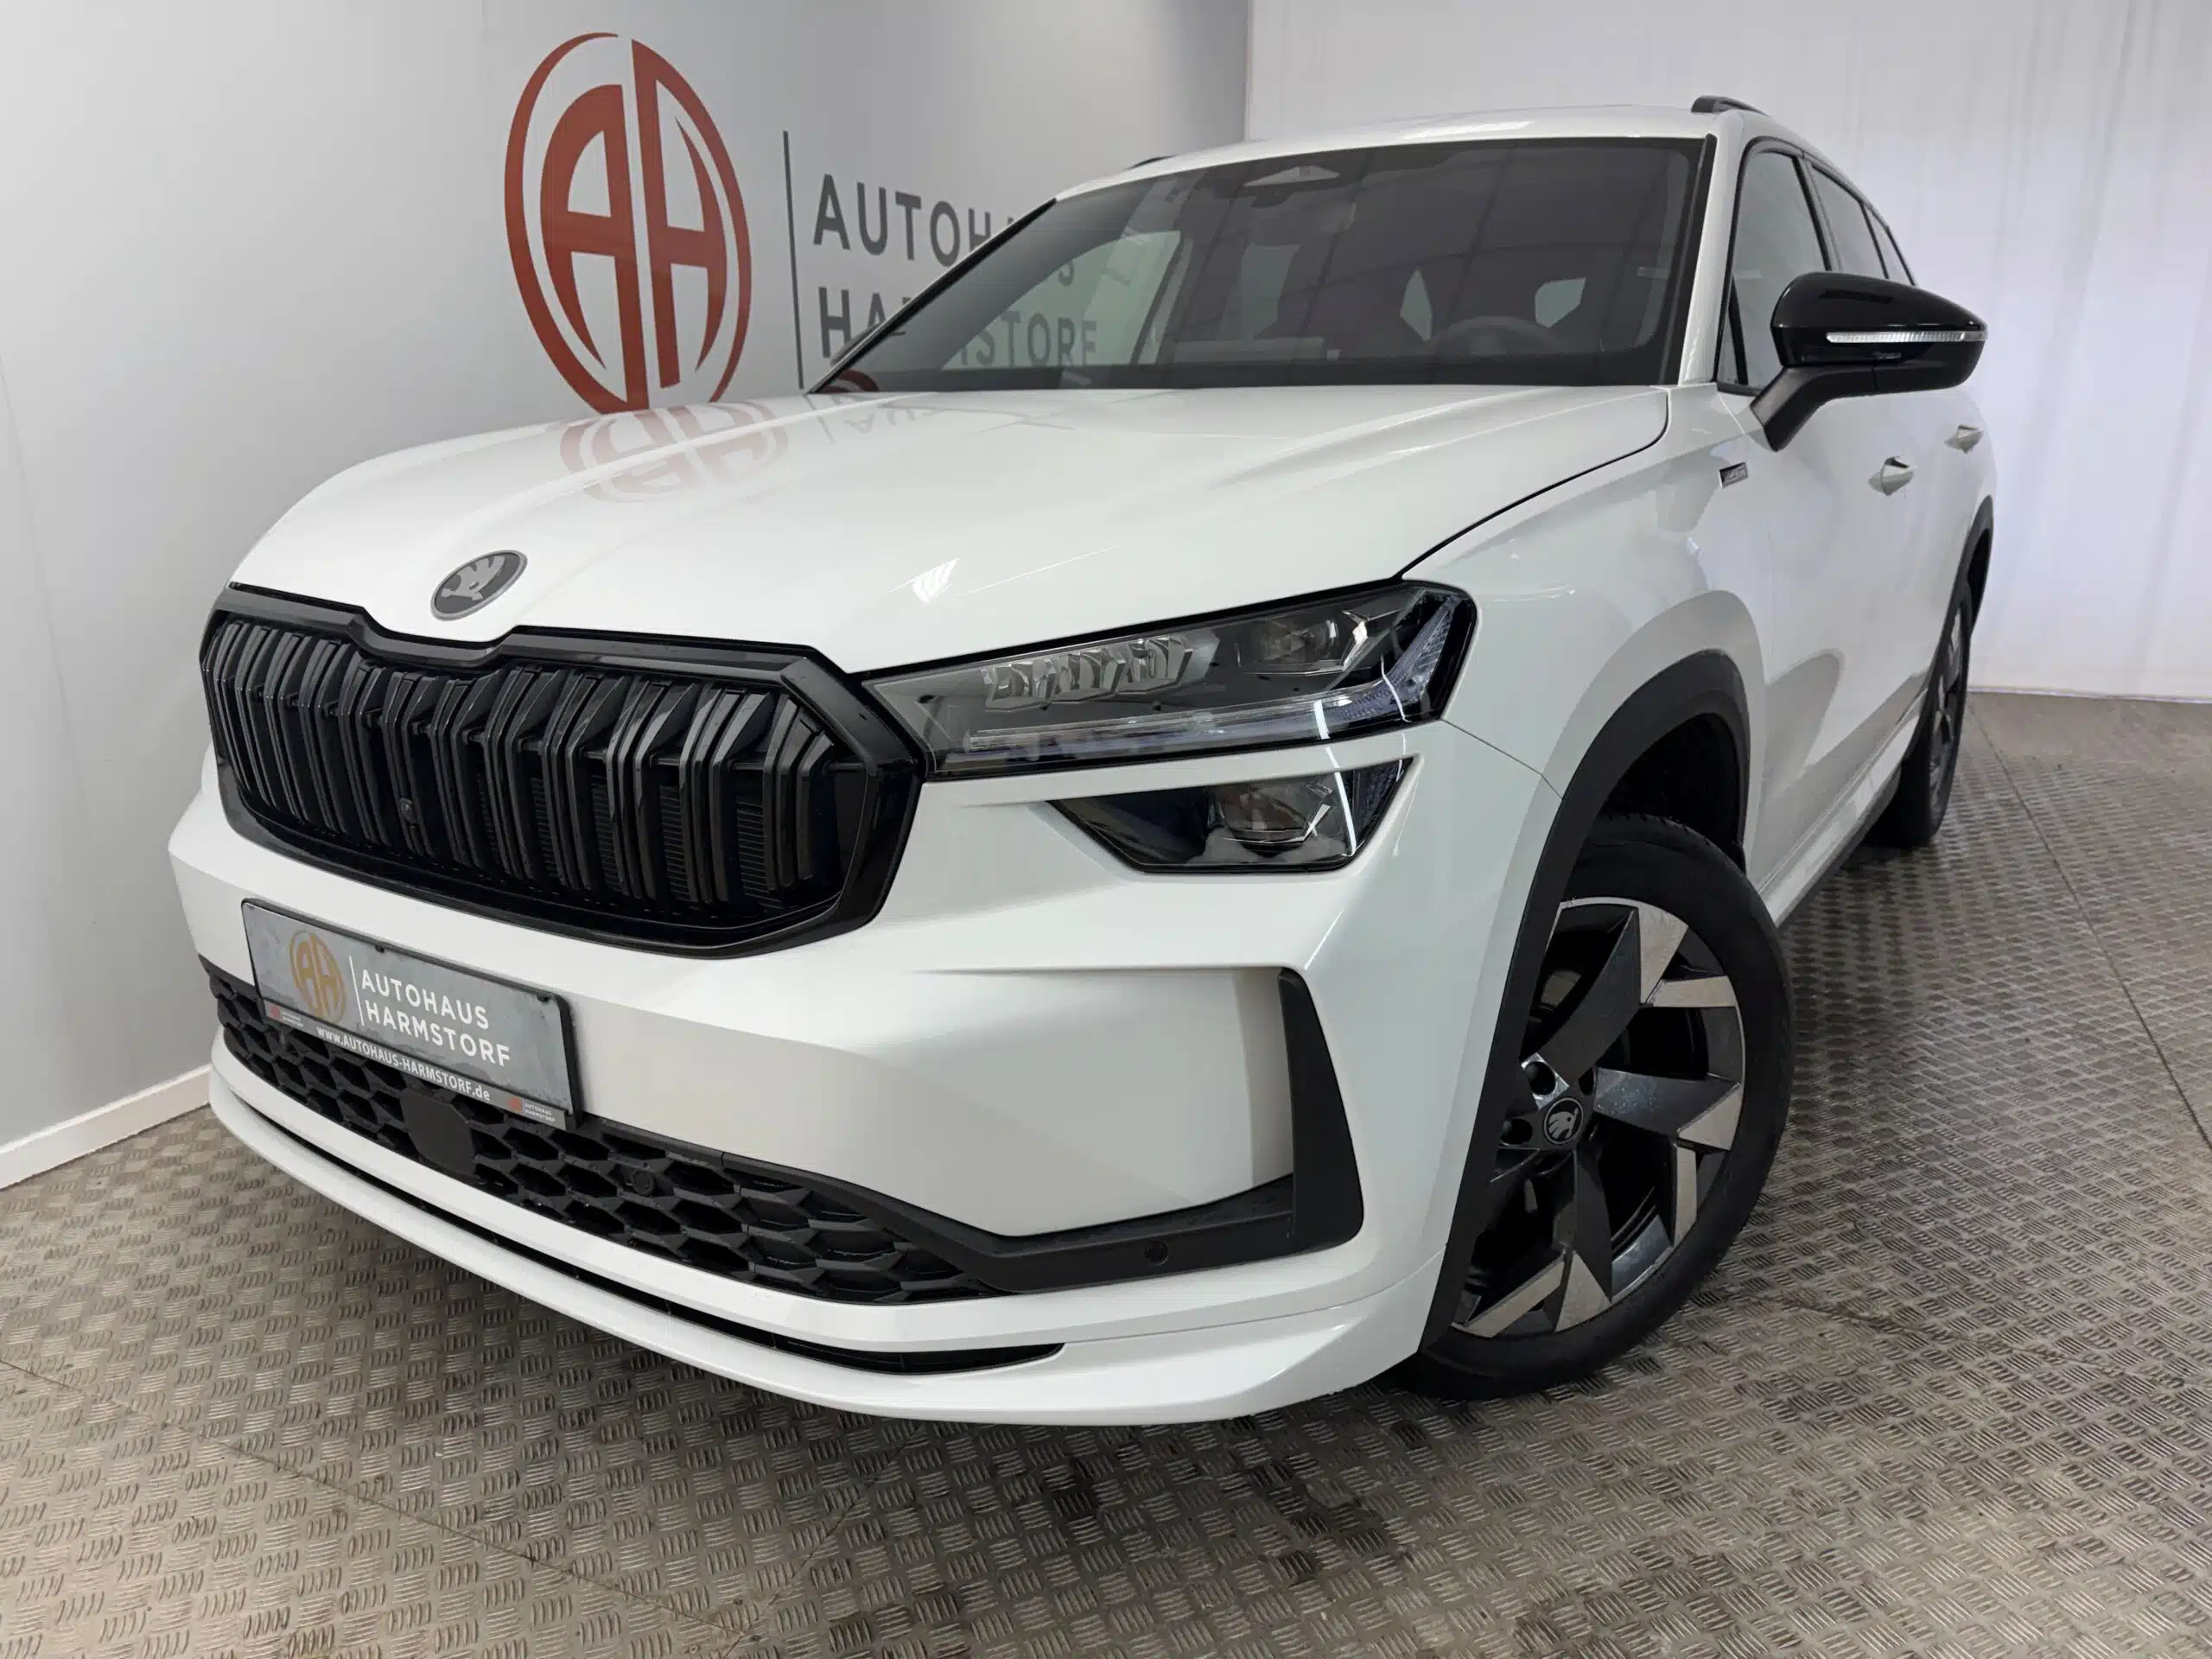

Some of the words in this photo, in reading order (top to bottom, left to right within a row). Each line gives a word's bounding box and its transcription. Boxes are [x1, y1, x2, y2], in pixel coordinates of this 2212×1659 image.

[361, 969, 490, 1030] AUTOHAUS
[316, 1027, 491, 1102] www.AUTOHAUS-HARMSTORF.de
[365, 1000, 511, 1066] HARMSTORF
